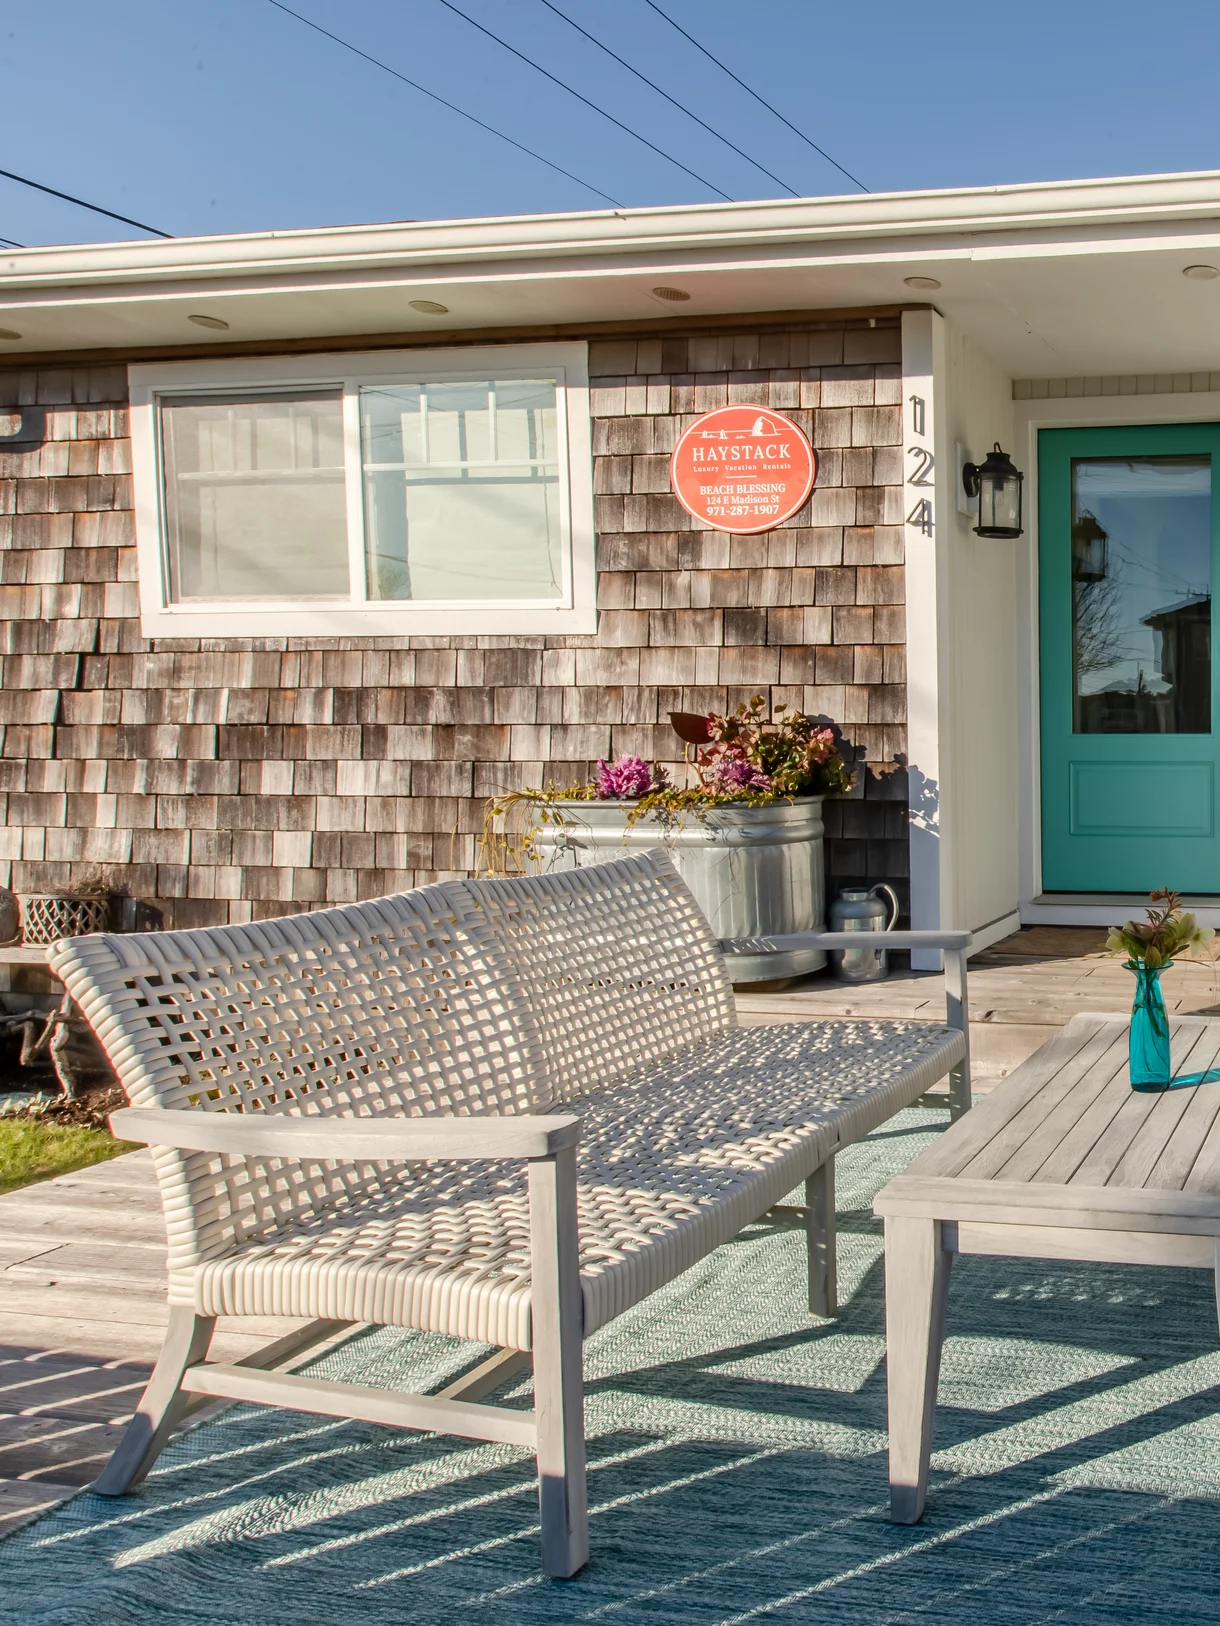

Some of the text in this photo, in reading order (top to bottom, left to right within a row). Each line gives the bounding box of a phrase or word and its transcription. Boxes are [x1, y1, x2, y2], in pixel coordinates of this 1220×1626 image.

[692, 444, 791, 461] HAYSTACK
[905, 394, 929, 535] 124
[700, 484, 786, 495] BEACH BLESSING
[707, 494, 780, 504] 124 E Madison St
[706, 505, 779, 516] 971-287-1907
